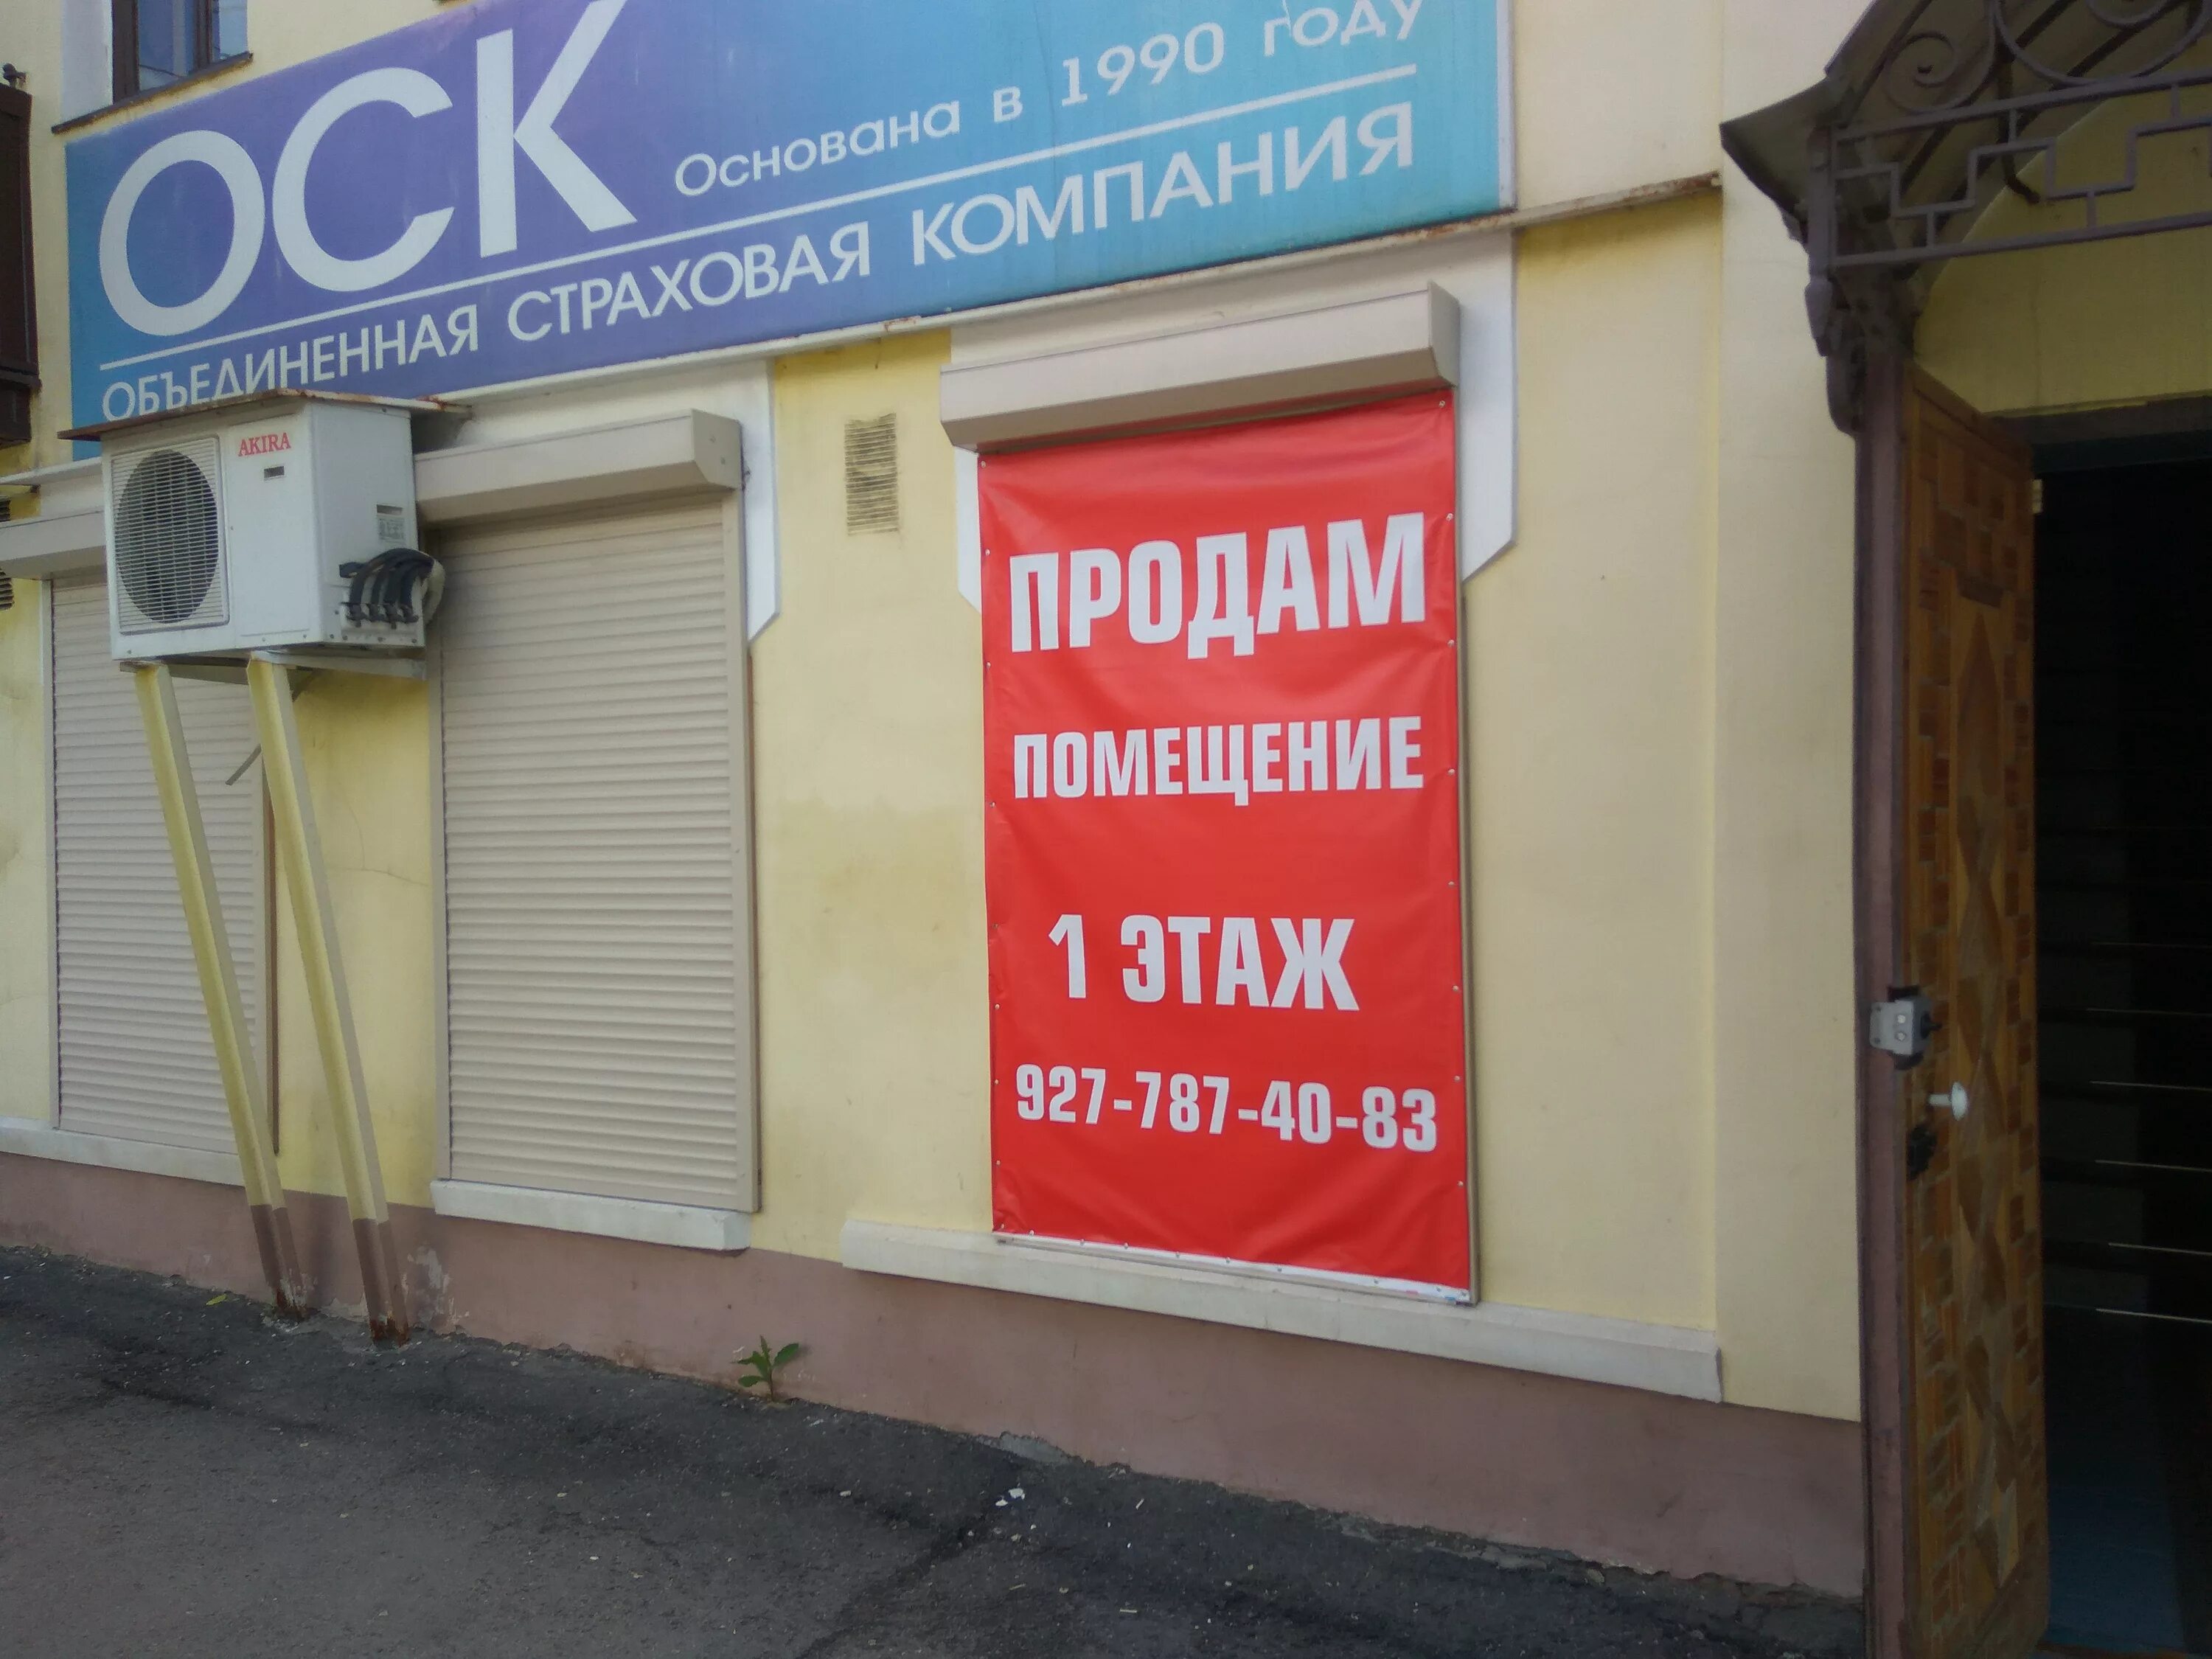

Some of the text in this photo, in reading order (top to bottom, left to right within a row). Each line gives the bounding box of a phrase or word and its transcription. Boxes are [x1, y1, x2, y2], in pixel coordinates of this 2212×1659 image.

[675, 0, 1422, 198] Основана в 1990 году
[100, 0, 636, 335] ОСК
[102, 102, 1413, 422] ОБЪЕДИНЕННАЯ СТРАХОВАЯ КОМПАНИЯ
[237, 432, 292, 457] AKIRA
[1009, 512, 1425, 659] ПРОДАМ
[1013, 716, 1424, 806] ПОМЕЩЕНИЕ
[1048, 914, 1360, 1010] 1 ЭТАЖ
[1016, 1064, 1437, 1152] 927-787-40-83
